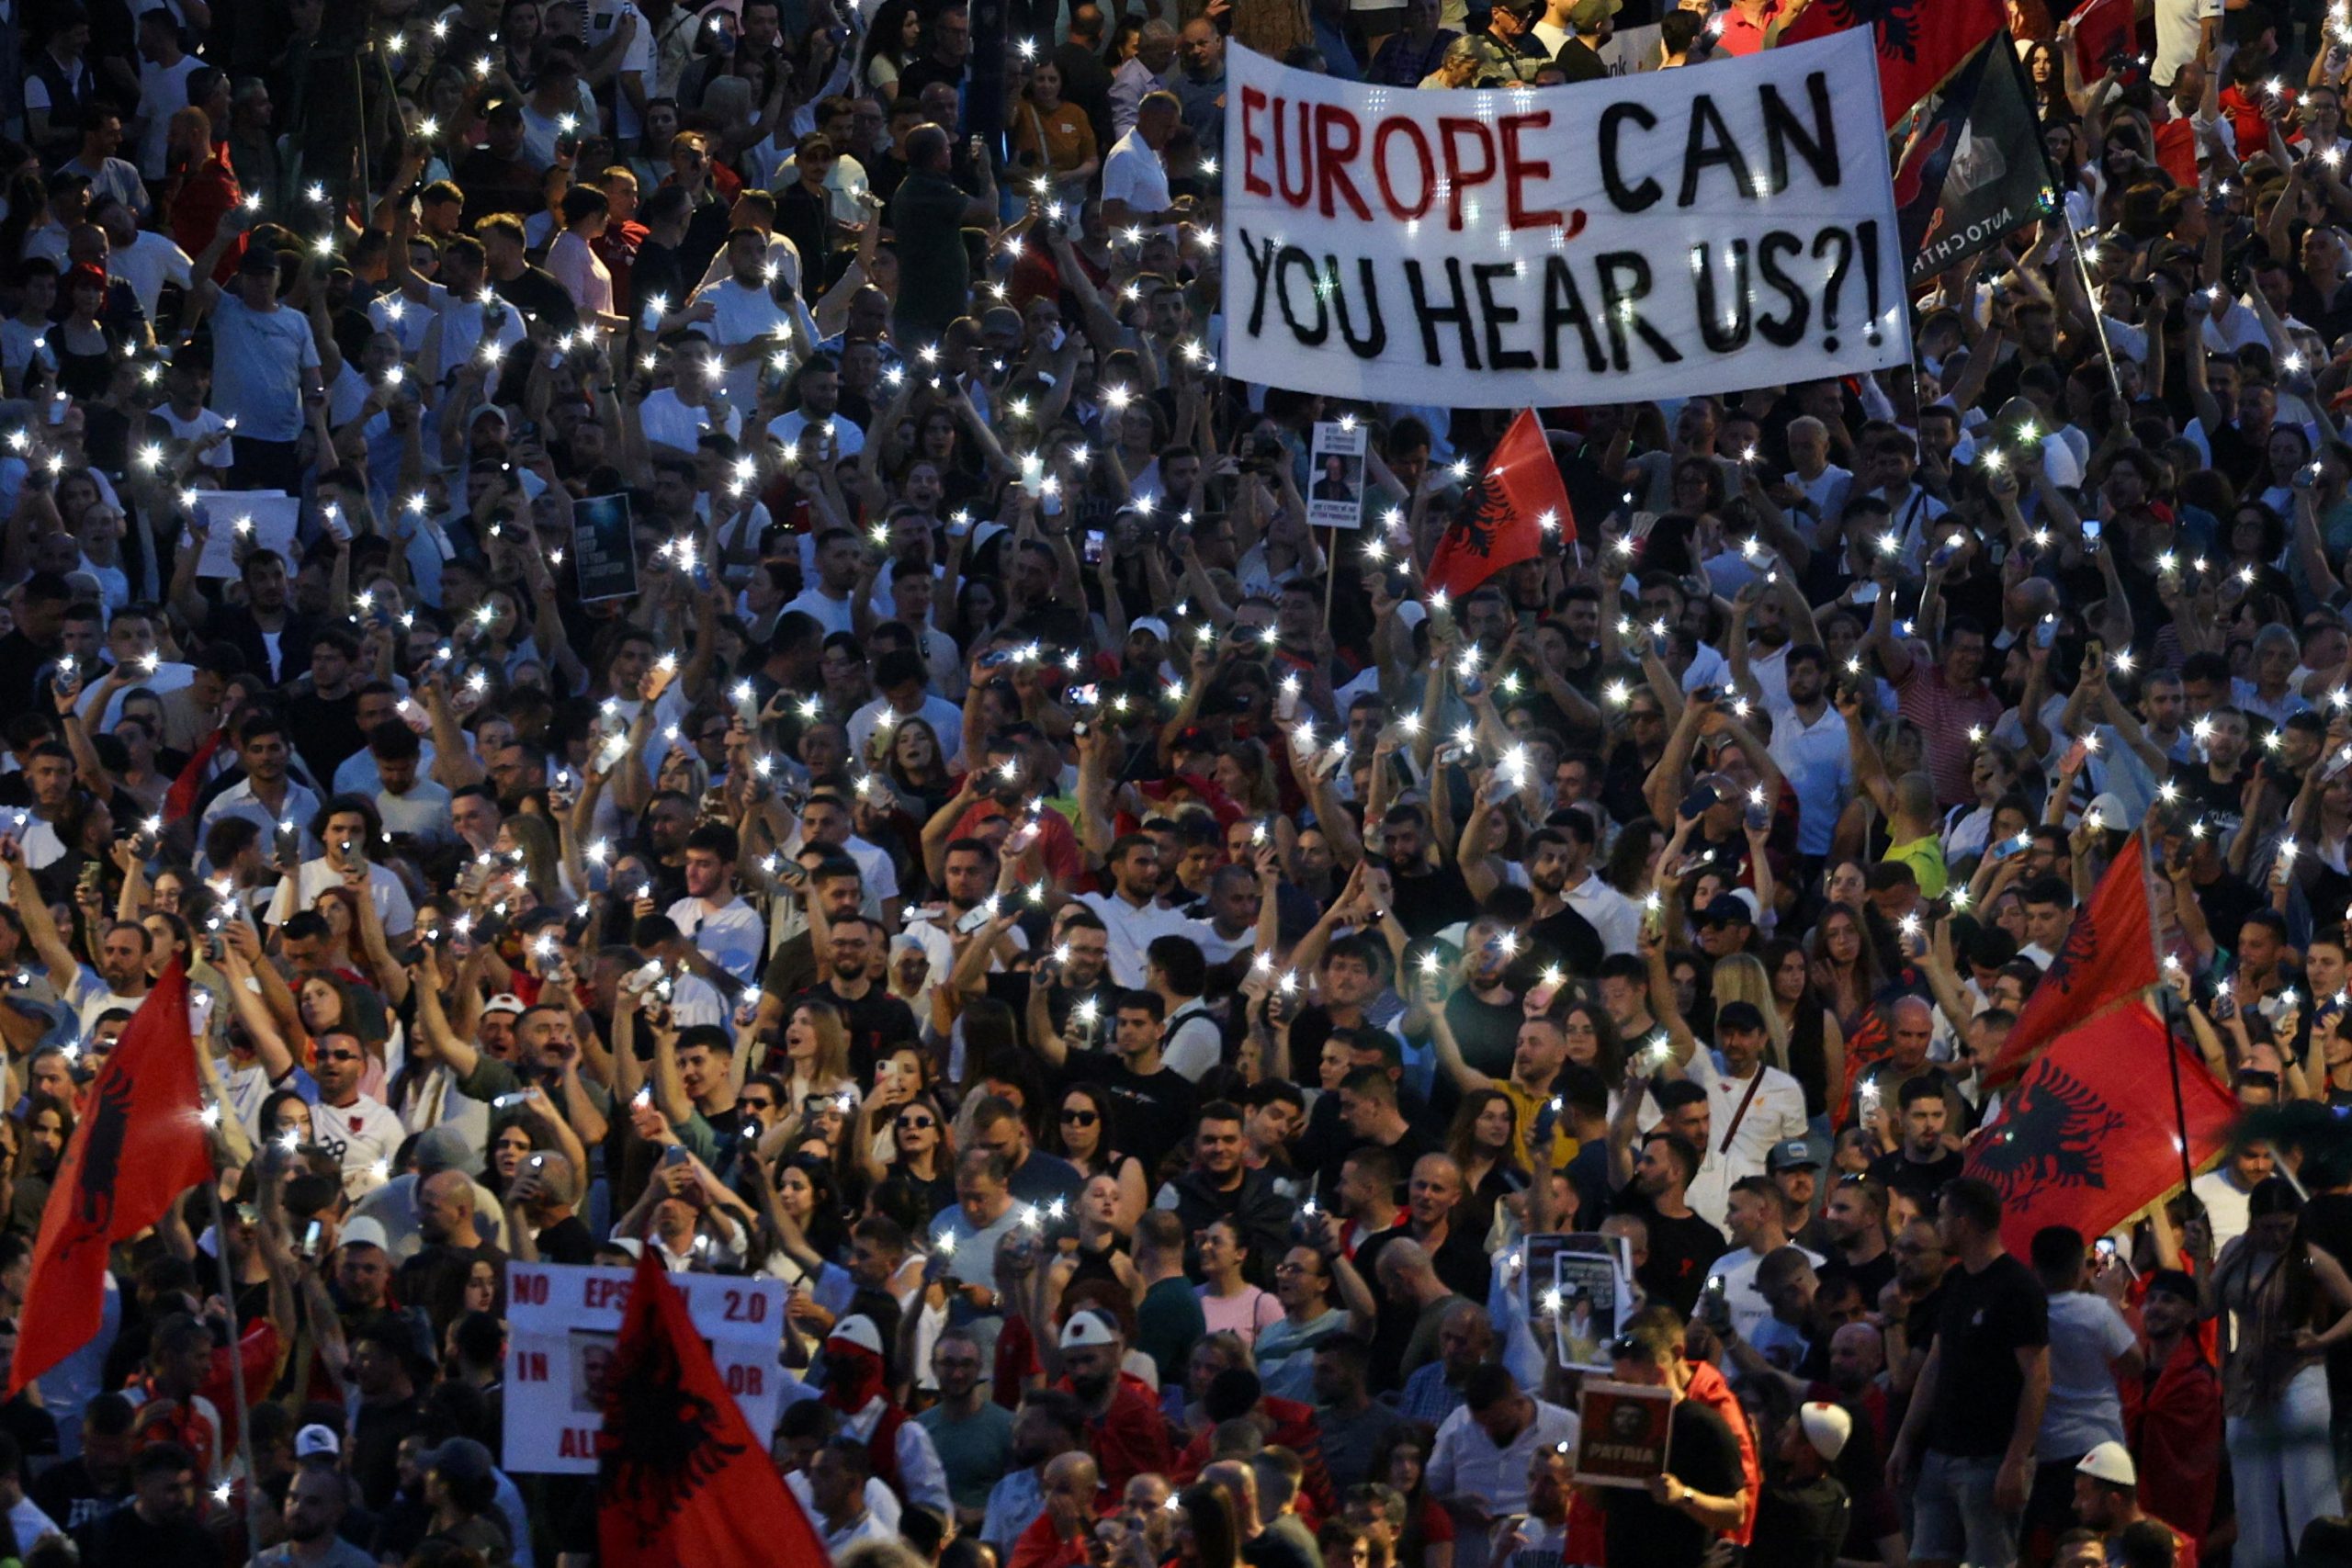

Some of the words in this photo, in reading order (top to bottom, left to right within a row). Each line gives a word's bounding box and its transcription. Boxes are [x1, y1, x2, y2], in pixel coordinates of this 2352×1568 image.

[1242, 85, 1586, 238] EUROPE,
[1599, 72, 1841, 213] CAN
[1240, 229, 1387, 359] YOU
[1405, 251, 1683, 372] HEAR
[1695, 220, 1879, 353] US?!
[513, 1274, 548, 1305] NO
[517, 1351, 548, 1382] IN
[728, 1364, 763, 1395] OR
